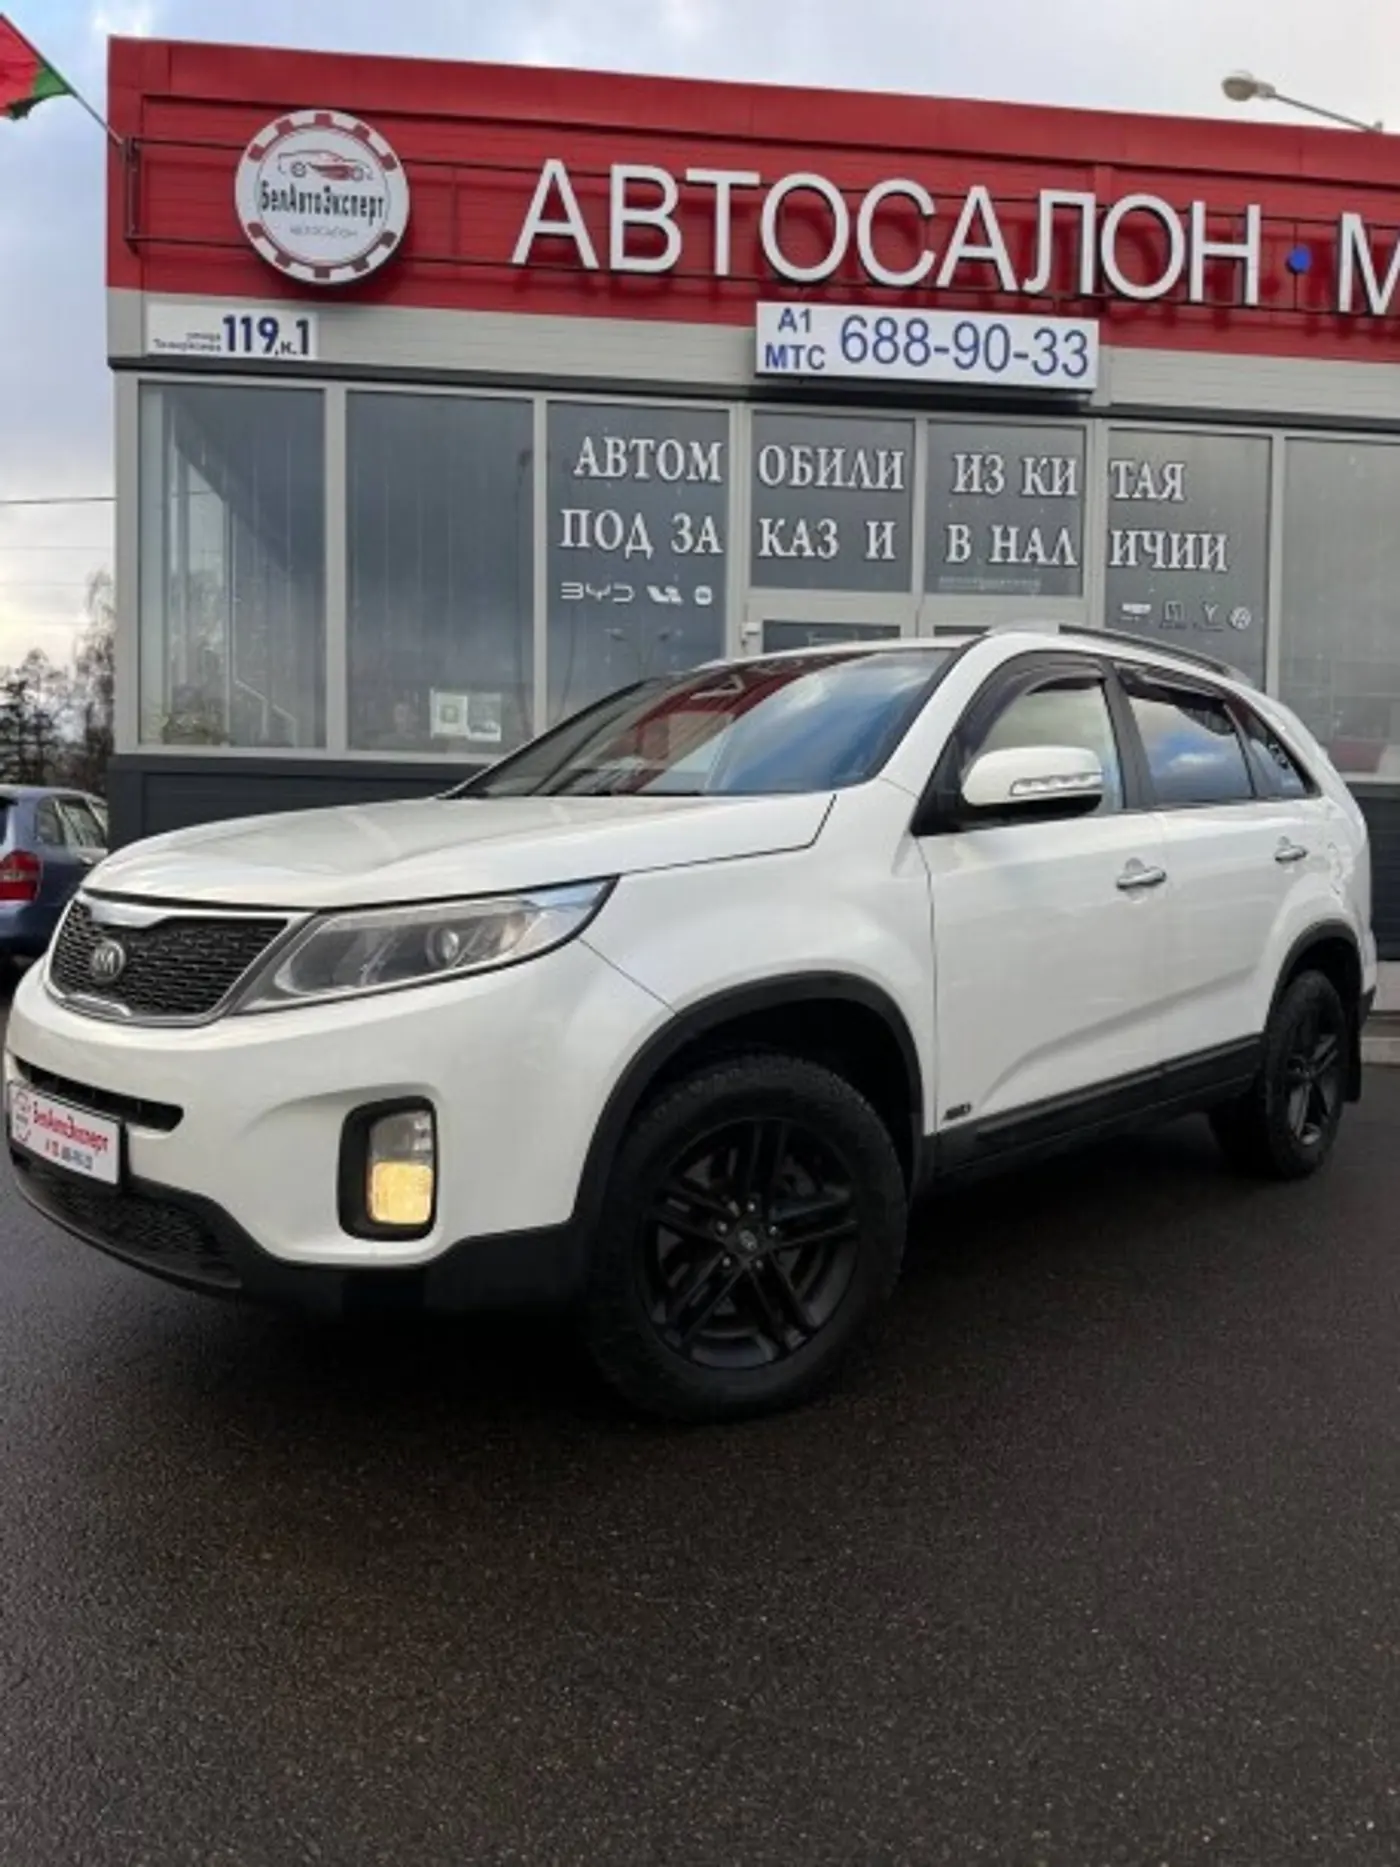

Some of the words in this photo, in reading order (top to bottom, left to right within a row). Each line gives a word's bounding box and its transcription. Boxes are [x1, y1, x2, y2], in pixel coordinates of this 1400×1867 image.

[260, 179, 385, 226] БелАвтоЭксперт
[511, 157, 1261, 308] АВТОСАЛОН
[840, 314, 1089, 378] 688-90-33
[573, 435, 723, 483] АВТОМ
[758, 444, 905, 490] ОБИЛИ
[952, 454, 1005, 494] ИЗ
[1020, 457, 1079, 496] КИ
[1109, 460, 1186, 501] ТАЯ
[560, 508, 654, 560] ПОД
[670, 513, 724, 554] ЗА
[757, 518, 840, 560] КАЗ
[865, 520, 897, 560] И
[946, 523, 971, 563] В
[988, 525, 1079, 566] НАЛ
[1108, 529, 1229, 572] ИЧИИ
